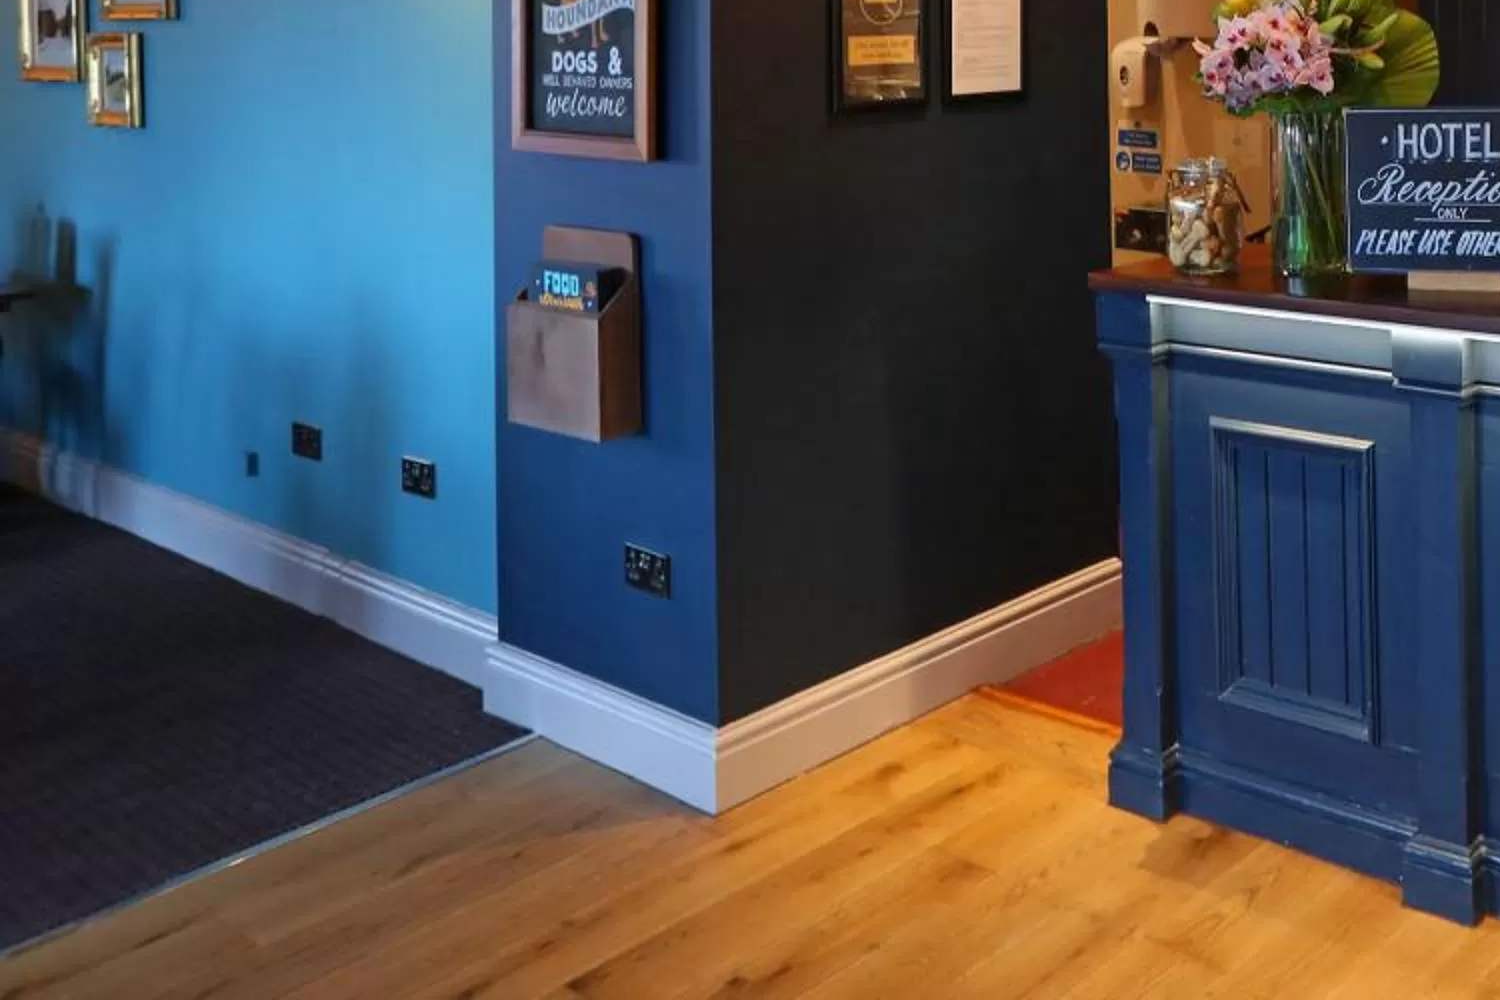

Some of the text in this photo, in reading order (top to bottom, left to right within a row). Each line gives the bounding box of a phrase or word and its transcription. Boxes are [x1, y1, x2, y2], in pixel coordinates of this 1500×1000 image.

[551, 46, 622, 76] DOGS &
[545, 87, 627, 117] welcome
[1437, 206, 1469, 220] ONLY
[1355, 228, 1419, 255] PLEASE
[1417, 228, 1456, 257] USE
[543, 269, 579, 296] FOOD
